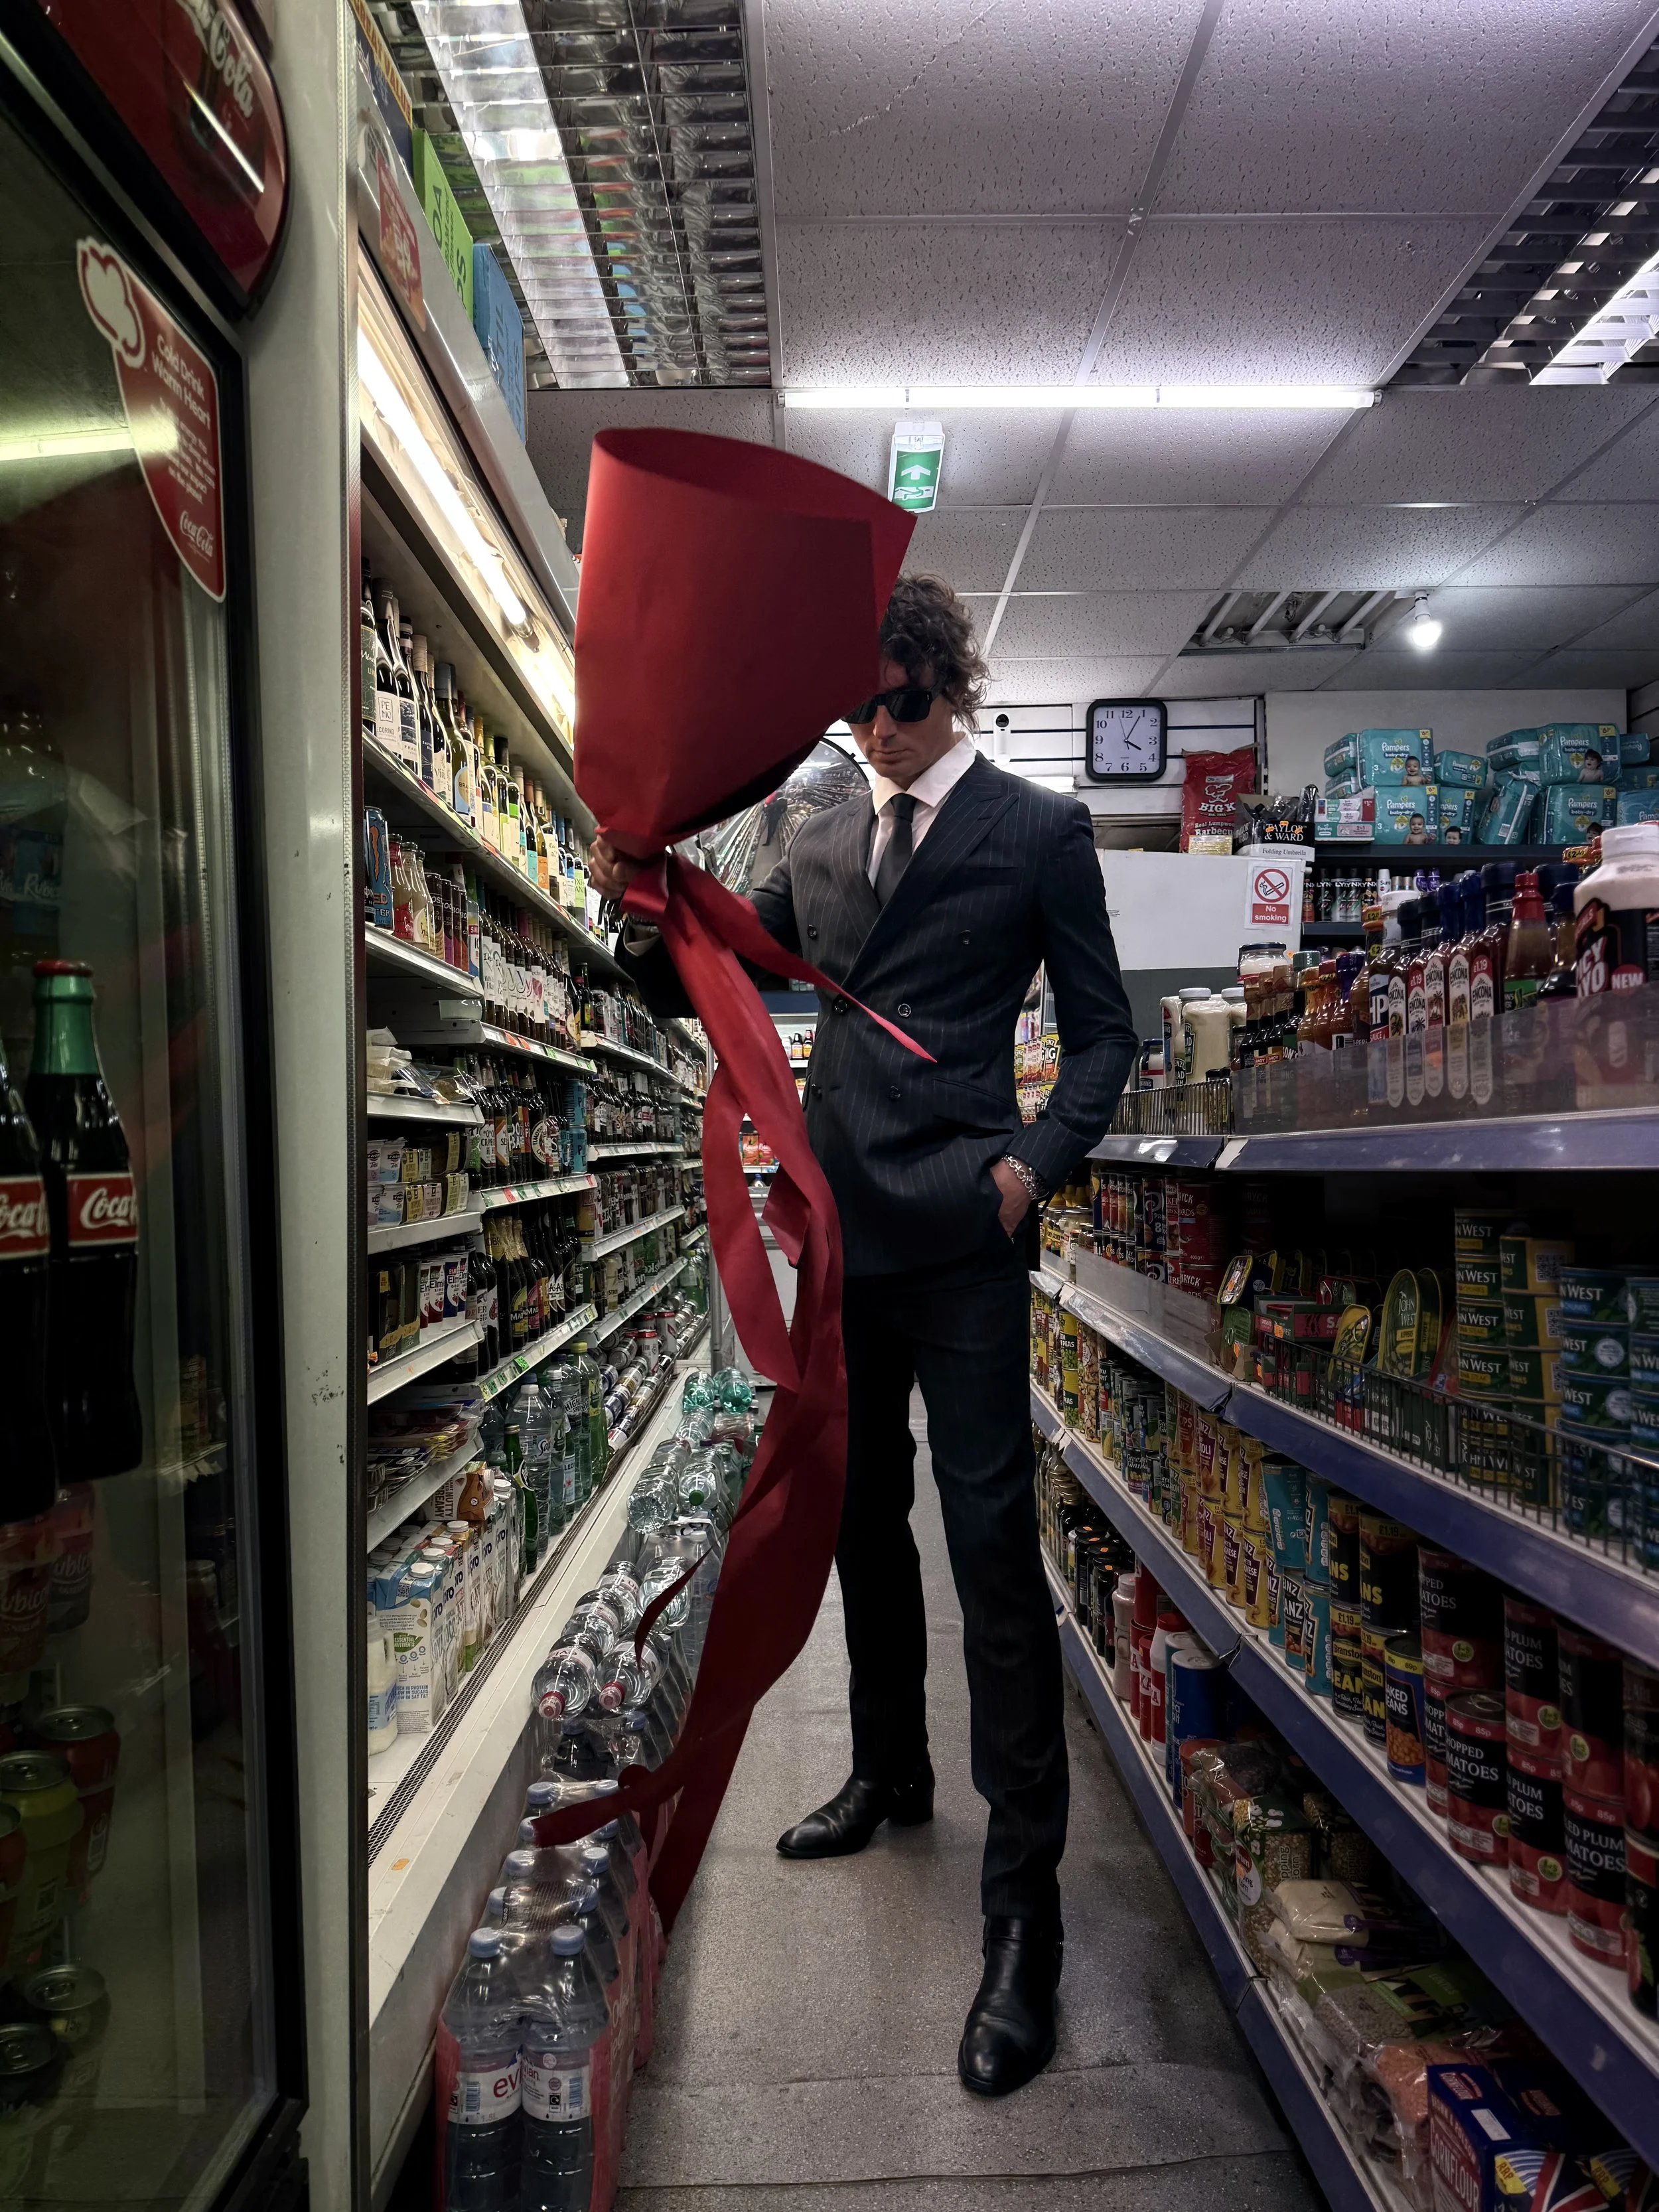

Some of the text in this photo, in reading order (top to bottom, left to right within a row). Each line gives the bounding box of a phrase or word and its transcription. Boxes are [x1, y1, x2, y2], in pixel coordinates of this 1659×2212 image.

[1106, 710, 1114, 719] 11
[1121, 709, 1133, 719] 12
[1141, 709, 1146, 718] 1
[1096, 720, 1107, 729] 10
[1150, 718, 1158, 727] 2
[1095, 735, 1104, 745] 9
[1149, 736, 1157, 745] 3
[1560, 736, 1589, 747] Pampers
[1382, 741, 1410, 752] Pampers
[1095, 753, 1104, 762] 8
[1148, 753, 1157, 762] 4
[1105, 763, 1113, 772] 7
[1120, 763, 1129, 772] 6
[1139, 763, 1147, 772] 5
[1198, 802, 1224, 813] BIG
[1224, 801, 1236, 811] K
[1386, 800, 1415, 810] Pampers
[1568, 798, 1597, 808] Pampers
[1638, 811, 1659, 821] Pamp
[1194, 828, 1233, 836] Barbecu
[1275, 833, 1304, 842] WARD
[1473, 960, 1488, 973] £1.19
[1410, 974, 1422, 986] £1.19
[1426, 970, 1443, 984] ENCONA
[1450, 968, 1468, 984] ENCONA
[1611, 973, 1644, 989] NEW
[1388, 988, 1404, 1003] ENCONA
[1472, 986, 1492, 1003] ENCONA
[1409, 998, 1425, 1013] ENCONA
[1463, 1225, 1493, 1238] WEST
[1467, 1270, 1498, 1284] WEST
[1565, 1284, 1604, 1301] WEST
[1469, 1313, 1499, 1327] WEST
[1469, 1359, 1502, 1374] WEST
[445, 1488, 454, 1518] NUTTY
[1338, 1613, 1354, 1625] £1.19
[1334, 1644, 1361, 1659] Bransto
[1475, 1726, 1492, 1737] 85p
[1521, 1759, 1536, 1773] 85p
[1597, 1810, 1616, 1823] 85p
[1583, 1830, 1624, 1852] PLUM
